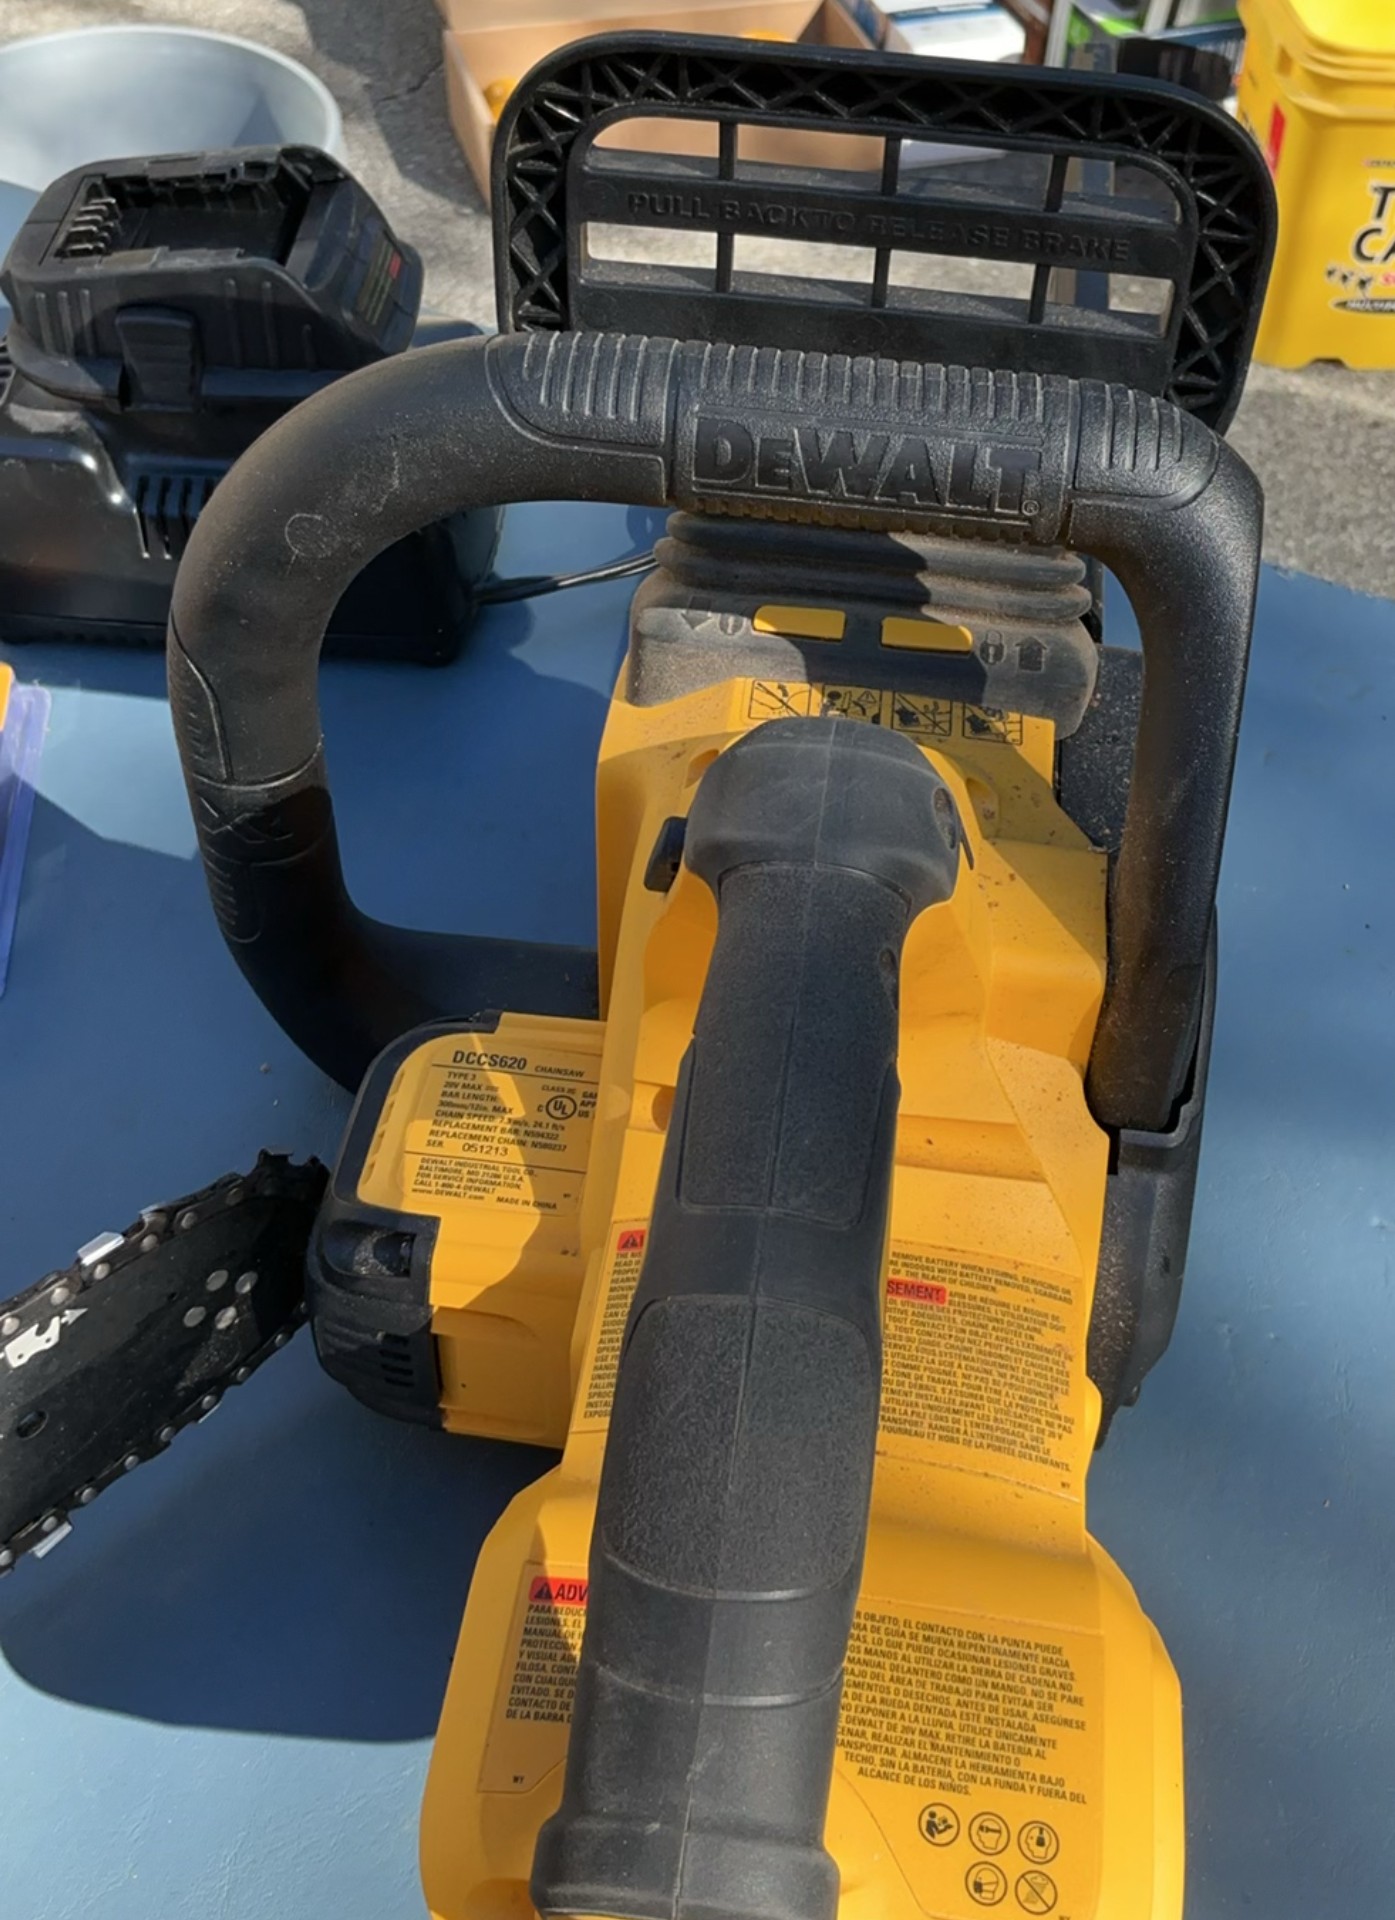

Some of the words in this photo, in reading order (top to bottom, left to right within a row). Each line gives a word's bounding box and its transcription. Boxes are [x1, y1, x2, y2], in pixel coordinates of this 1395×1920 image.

[627, 191, 711, 219] PULL
[870, 213, 1011, 248] RELEASE
[1021, 229, 1130, 261] BRAKE
[452, 1050, 527, 1070] DCCS620
[447, 1071, 469, 1080] TYPE
[534, 1065, 584, 1077] CHAINSAW
[440, 1089, 460, 1098] BAR
[460, 1082, 482, 1091] MAX
[434, 1109, 464, 1119] CHAIN
[491, 1105, 513, 1114] MAX
[432, 1118, 497, 1132] REPLACEMENT
[429, 1128, 495, 1143] REPLACEMENT
[461, 1142, 509, 1156] 051213
[415, 1171, 431, 1179] FOR
[495, 1195, 520, 1204] MADE
[520, 1198, 531, 1206] IN
[532, 1199, 558, 1209] CHINA
[527, 1604, 552, 1613] PARA
[523, 1626, 562, 1636] MANUAL
[903, 1617, 912, 1628] EL
[915, 1620, 963, 1638] CONTACTO
[966, 1629, 985, 1641] CON
[987, 1633, 998, 1644] LA
[1001, 1635, 1031, 1650] PUNTA
[1034, 1642, 1063, 1656] PUEDE
[869, 1623, 880, 1634] DE
[908, 1630, 919, 1641] SE
[922, 1632, 954, 1647] MUEVA
[956, 1639, 1039, 1663] REPENTINAMENTE
[1041, 1654, 1070, 1669] HACIA
[871, 1635, 882, 1646] LO
[885, 1638, 903, 1650] QUE
[905, 1641, 934, 1655] PUEDE
[937, 1647, 991, 1666] OCASIONAR
[993, 1657, 1036, 1674] LESIONES
[863, 1646, 898, 1661] MANOS
[900, 1652, 911, 1663] AL
[913, 1654, 953, 1670] UTILIZAR
[955, 1662, 967, 1673] LA
[970, 1664, 1003, 1679] SIERRA
[1005, 1671, 1016, 1682] DE
[513, 1673, 533, 1683] CON
[847, 1655, 886, 1670] MANUAL
[889, 1662, 942, 1680] DELANTERO
[944, 1671, 972, 1685] COMO
[975, 1677, 988, 1688] UN
[1030, 1688, 1044, 1699] NO
[1047, 1691, 1057, 1702] SE
[1060, 1693, 1084, 1707] PARE
[869, 1670, 885, 1682] DEL
[915, 1678, 926, 1689] DE
[930, 1681, 972, 1697] TRABAJO
[974, 1689, 999, 1703] PARA
[1002, 1694, 1034, 1709] EVITAR
[1036, 1700, 1054, 1713] SER
[893, 1686, 900, 1697] O
[955, 1697, 985, 1712] ANTES
[987, 1703, 999, 1714] DE
[507, 1696, 558, 1710] CONTACTO
[558, 1700, 572, 1711] DE
[851, 1691, 862, 1702] DE
[865, 1693, 876, 1704] LA
[879, 1696, 910, 1710] RUEDA
[912, 1702, 957, 1718] DENTADA
[983, 1714, 1036, 1733] INSTALADA
[505, 1709, 518, 1719] DE
[518, 1710, 532, 1720] LA
[532, 1711, 566, 1722] BARRA
[854, 1704, 897, 1720] EXPONER
[898, 1711, 906, 1722] A
[908, 1713, 919, 1724] LA
[958, 1722, 992, 1737] UTILICE
[845, 1714, 883, 1730] DEWALT
[886, 1721, 898, 1732] DE
[900, 1724, 916, 1735] 20V
[945, 1732, 976, 1746] RETIRE
[978, 1738, 990, 1749] LA
[1035, 1748, 1046, 1760] AL
[871, 1731, 915, 1748] REALIZAR
[917, 1739, 928, 1750] EL
[929, 1741, 1011, 1765] MANTENIMIENTO
[1013, 1757, 1020, 1767] O
[900, 1748, 952, 1766] ALMACENE
[954, 1758, 966, 1769] LA
[969, 1760, 1037, 1782] HERRAMIENTA
[1039, 1774, 1065, 1788] BAJO
[857, 1766, 901, 1783] ALCANCE
[903, 1774, 914, 1785] DE
[918, 1776, 935, 1789] LOS
[879, 1756, 896, 1769] SIN
[898, 1760, 909, 1771] LA
[957, 1770, 977, 1783] CON
[979, 1774, 991, 1786] LA
[993, 1777, 1026, 1793] FUNDA
[1028, 1784, 1035, 1794] Y
[1036, 1785, 1067, 1801] FUERA
[1069, 1792, 1087, 1805] DEL
